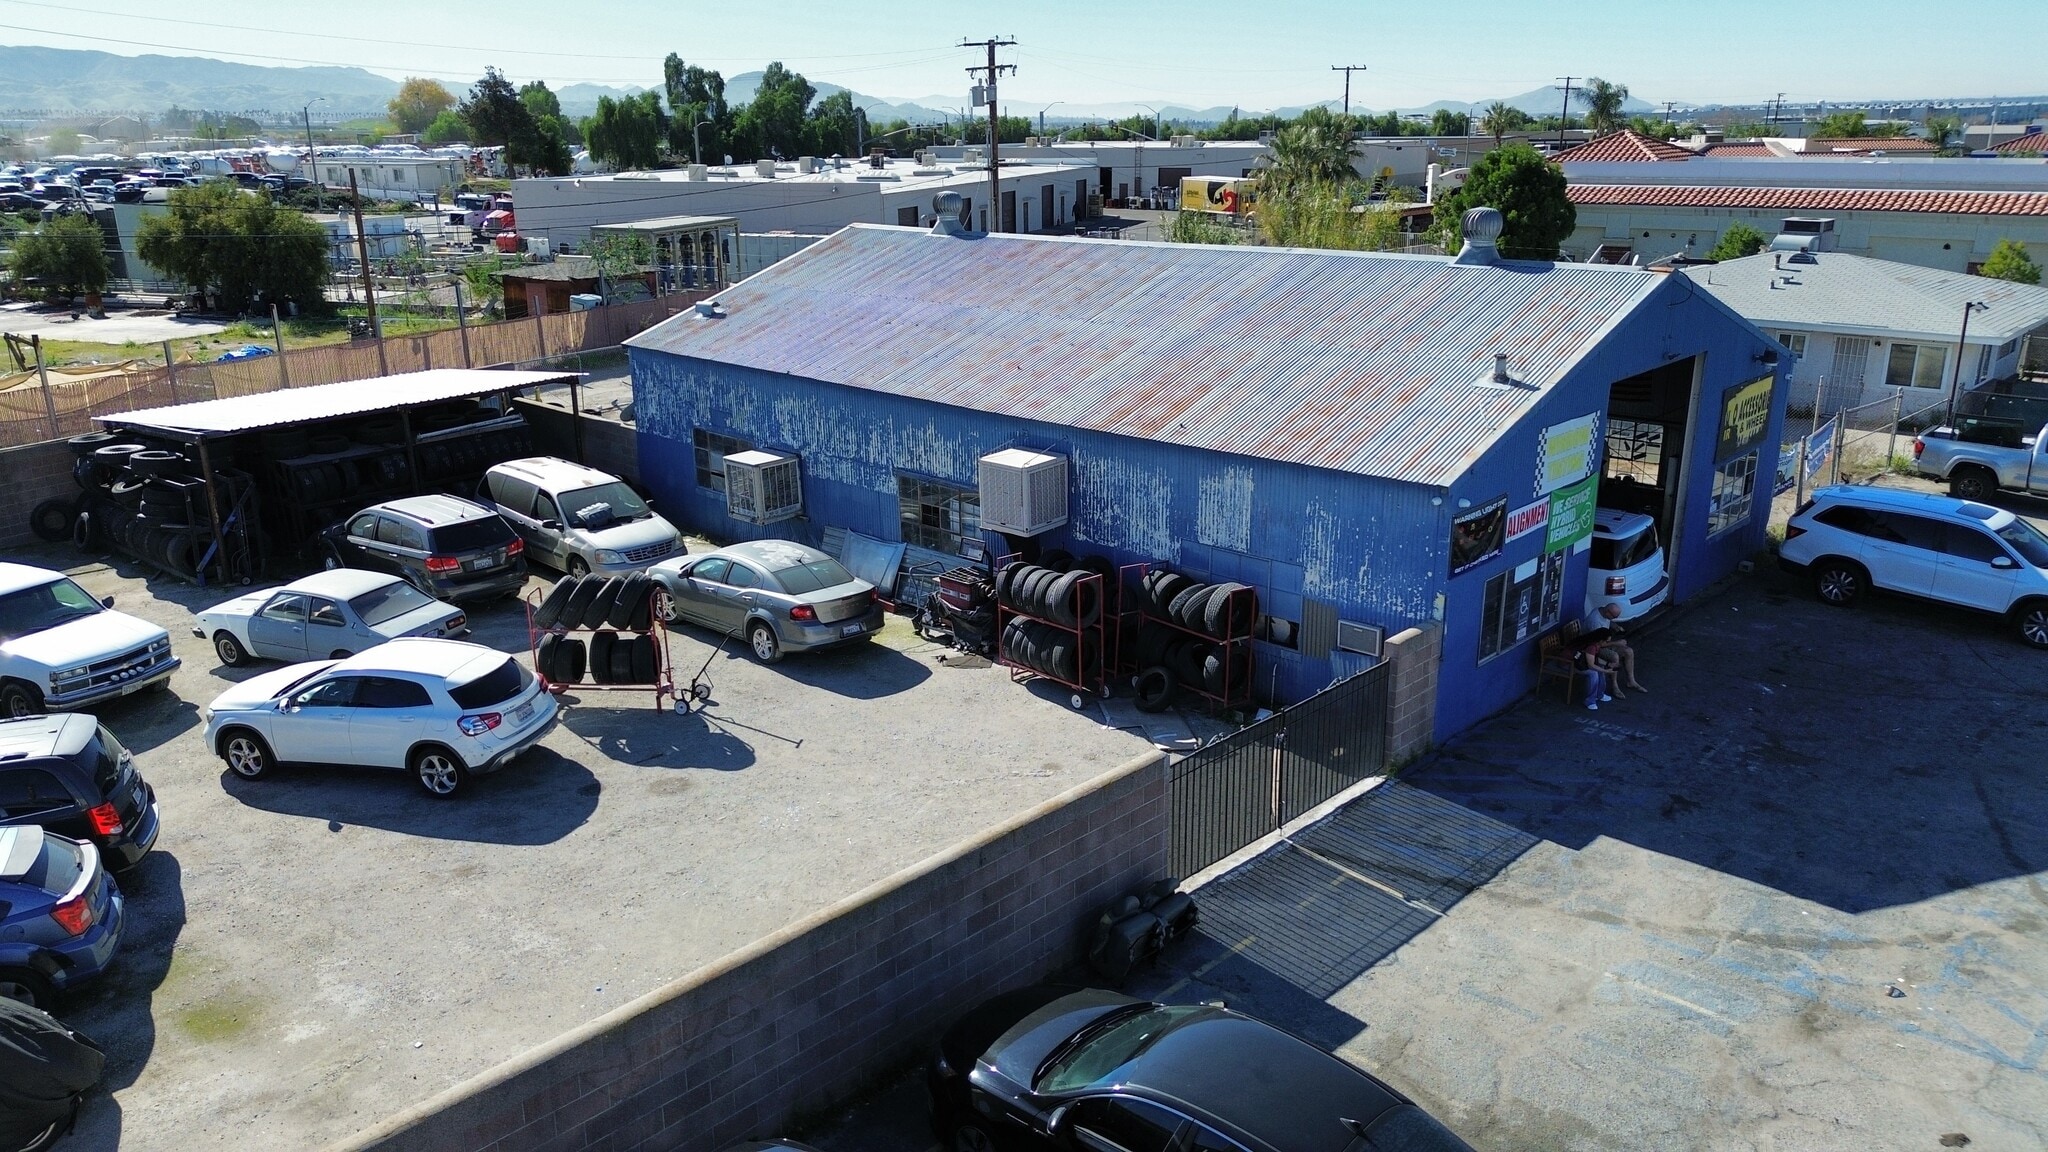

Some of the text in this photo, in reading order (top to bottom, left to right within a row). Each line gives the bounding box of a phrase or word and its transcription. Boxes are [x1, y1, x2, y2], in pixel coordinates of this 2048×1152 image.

[1552, 486, 1591, 515] WE SERVICE
[1454, 510, 1482, 525] WARNING
[1507, 500, 1549, 538] ALIGNMENT
[1550, 507, 1576, 529] HYBRID
[1550, 520, 1580, 543] VEHICLES
